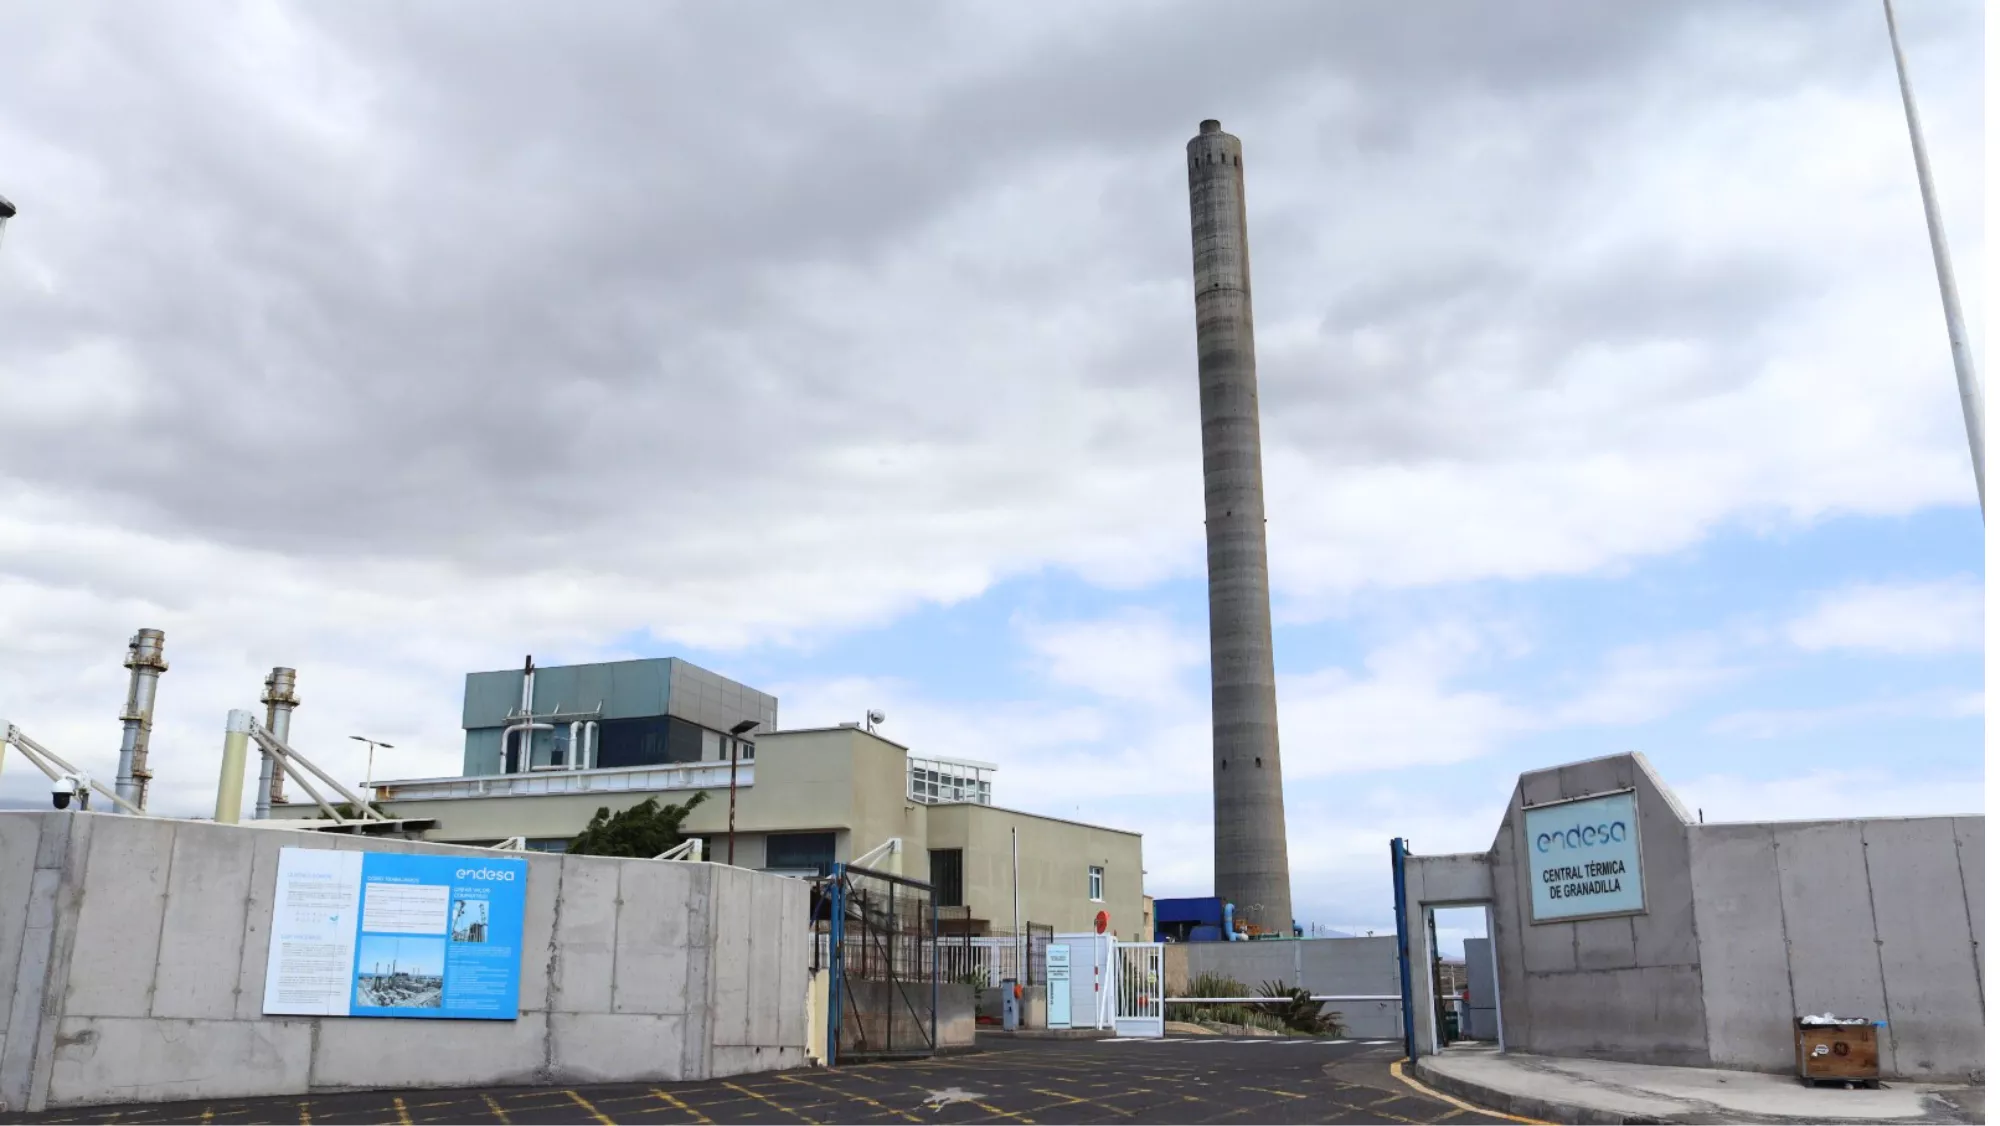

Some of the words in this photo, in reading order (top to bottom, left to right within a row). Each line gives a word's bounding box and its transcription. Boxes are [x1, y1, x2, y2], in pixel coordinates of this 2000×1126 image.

[1537, 821, 1626, 853] endesa
[456, 867, 515, 881] endesa
[1543, 866, 1583, 883] CENTRAL
[1584, 860, 1625, 878] TÉRMICA
[1550, 886, 1562, 899] DE
[1564, 879, 1621, 897] GRANADILLA
